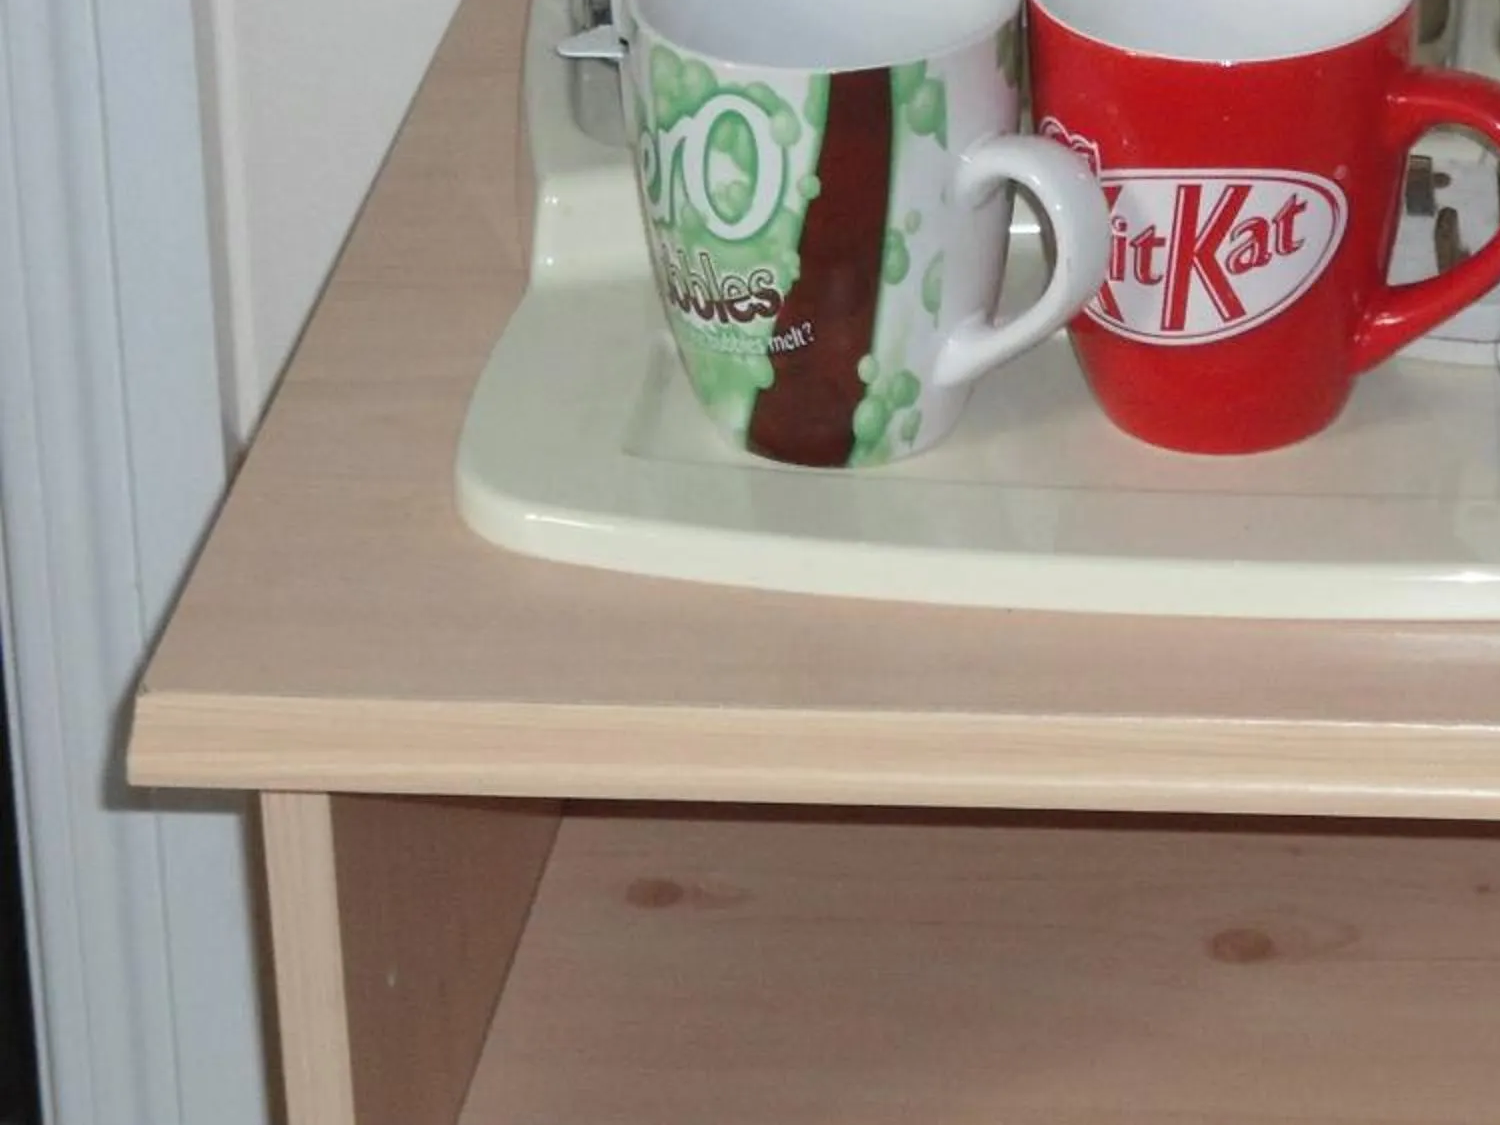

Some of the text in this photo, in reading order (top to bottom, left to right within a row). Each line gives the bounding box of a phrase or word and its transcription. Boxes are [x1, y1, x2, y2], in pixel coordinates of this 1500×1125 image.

[640, 92, 785, 242] ero
[661, 242, 782, 324] bbles
[768, 322, 815, 354] melt?
